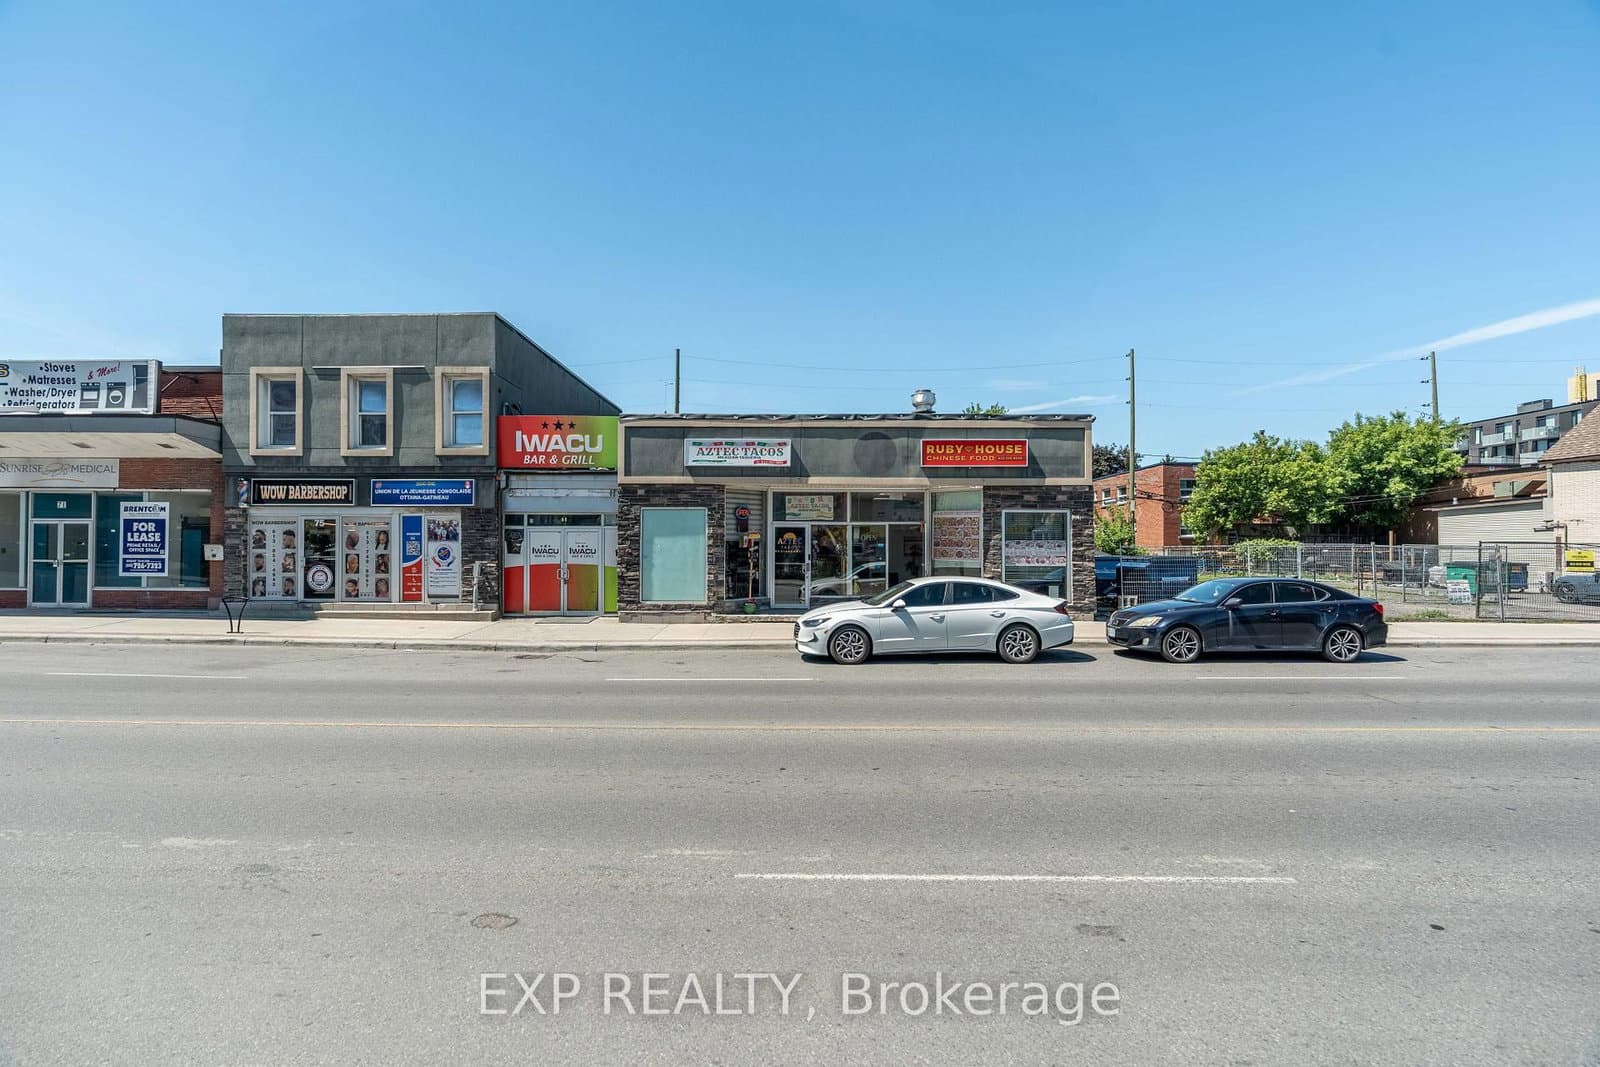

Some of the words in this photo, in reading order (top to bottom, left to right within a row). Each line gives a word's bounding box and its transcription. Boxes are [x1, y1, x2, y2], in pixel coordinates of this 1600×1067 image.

[44, 362, 76, 372] Stoves
[96, 360, 121, 377] More!
[27, 375, 77, 385] Matresses
[9, 387, 77, 398] Washer/Dryer
[515, 430, 604, 453] IWACU
[696, 447, 740, 456] AZTEC
[741, 447, 784, 457] TACOS
[926, 445, 964, 454] RUBY
[975, 445, 1023, 454] HOUSE
[523, 455, 546, 465] BAR
[549, 455, 558, 465] &
[562, 455, 596, 465] GRILL
[0, 462, 43, 473] SUNRISE
[70, 464, 117, 473] MEDICAL
[260, 485, 287, 500] WOW
[288, 485, 348, 500] BARBERSHOP
[123, 504, 166, 513] BRENTCOM
[132, 522, 156, 532] FOR
[314, 519, 325, 527] 75
[127, 532, 161, 542] LEASE
[777, 536, 803, 545] AZTEC
[531, 547, 560, 555] IWACU
[569, 547, 597, 555] IWACU
